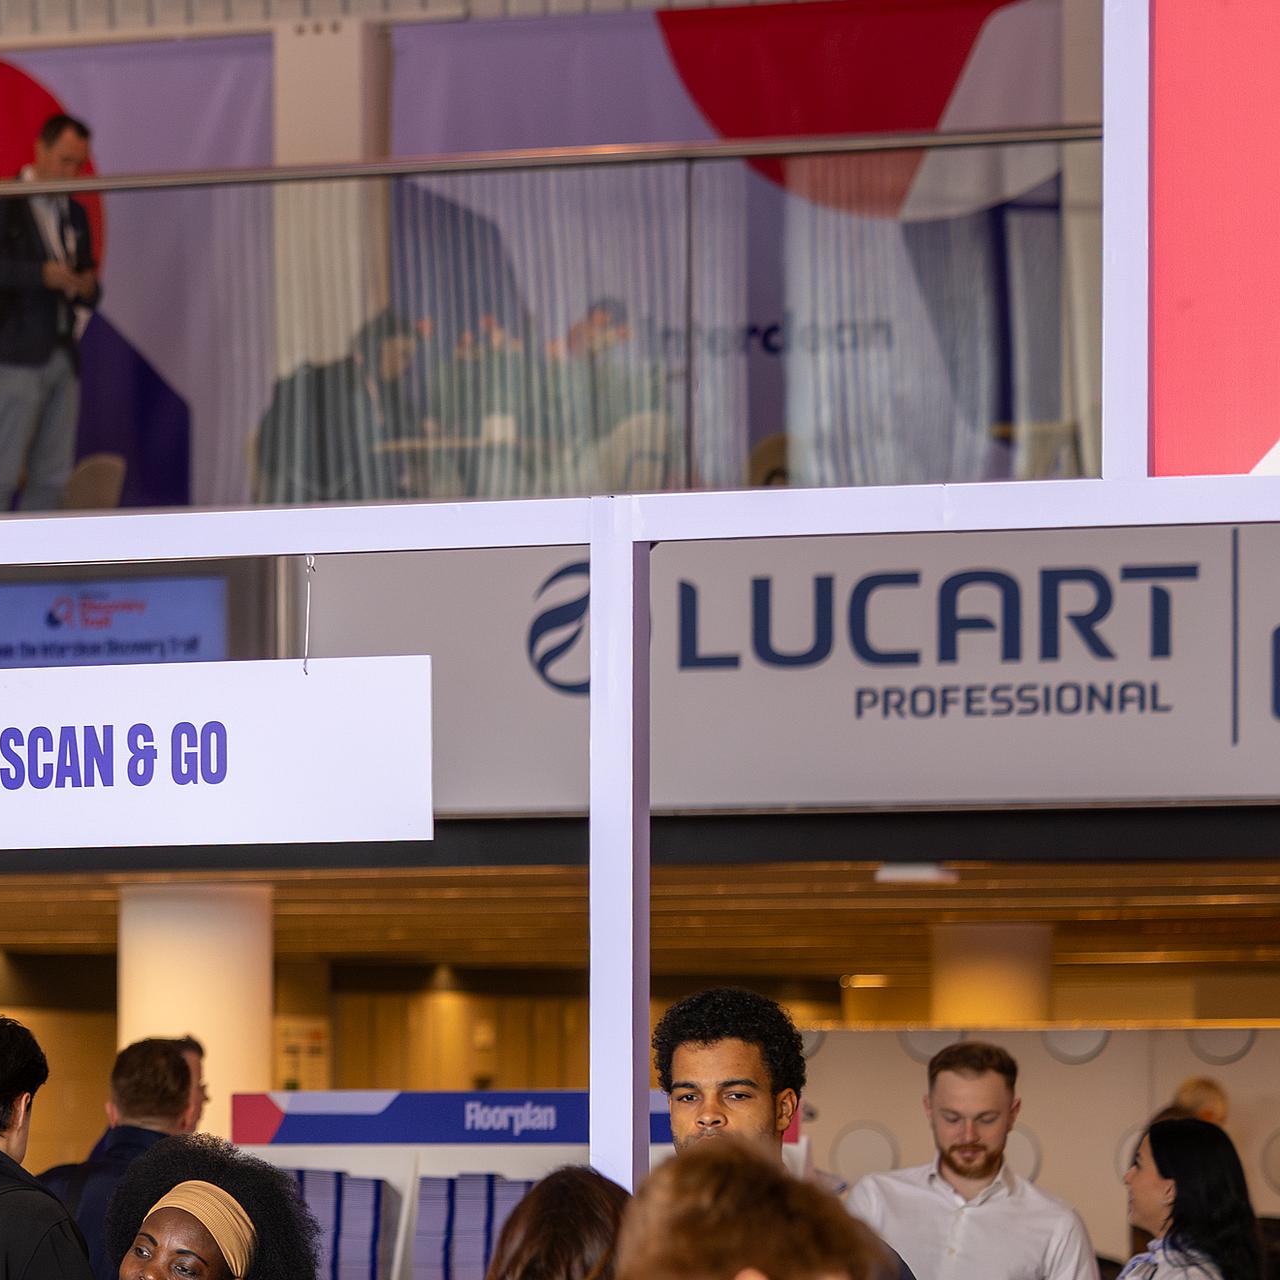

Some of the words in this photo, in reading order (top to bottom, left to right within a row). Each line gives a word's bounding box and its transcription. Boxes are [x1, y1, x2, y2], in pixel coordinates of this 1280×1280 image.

[677, 563, 1200, 671] LUCART
[856, 681, 1172, 720] PROFESSIONAL
[0, 724, 115, 790] SCAN
[127, 722, 157, 786] &
[171, 720, 228, 785] GO
[464, 1101, 557, 1136] Floorplan
